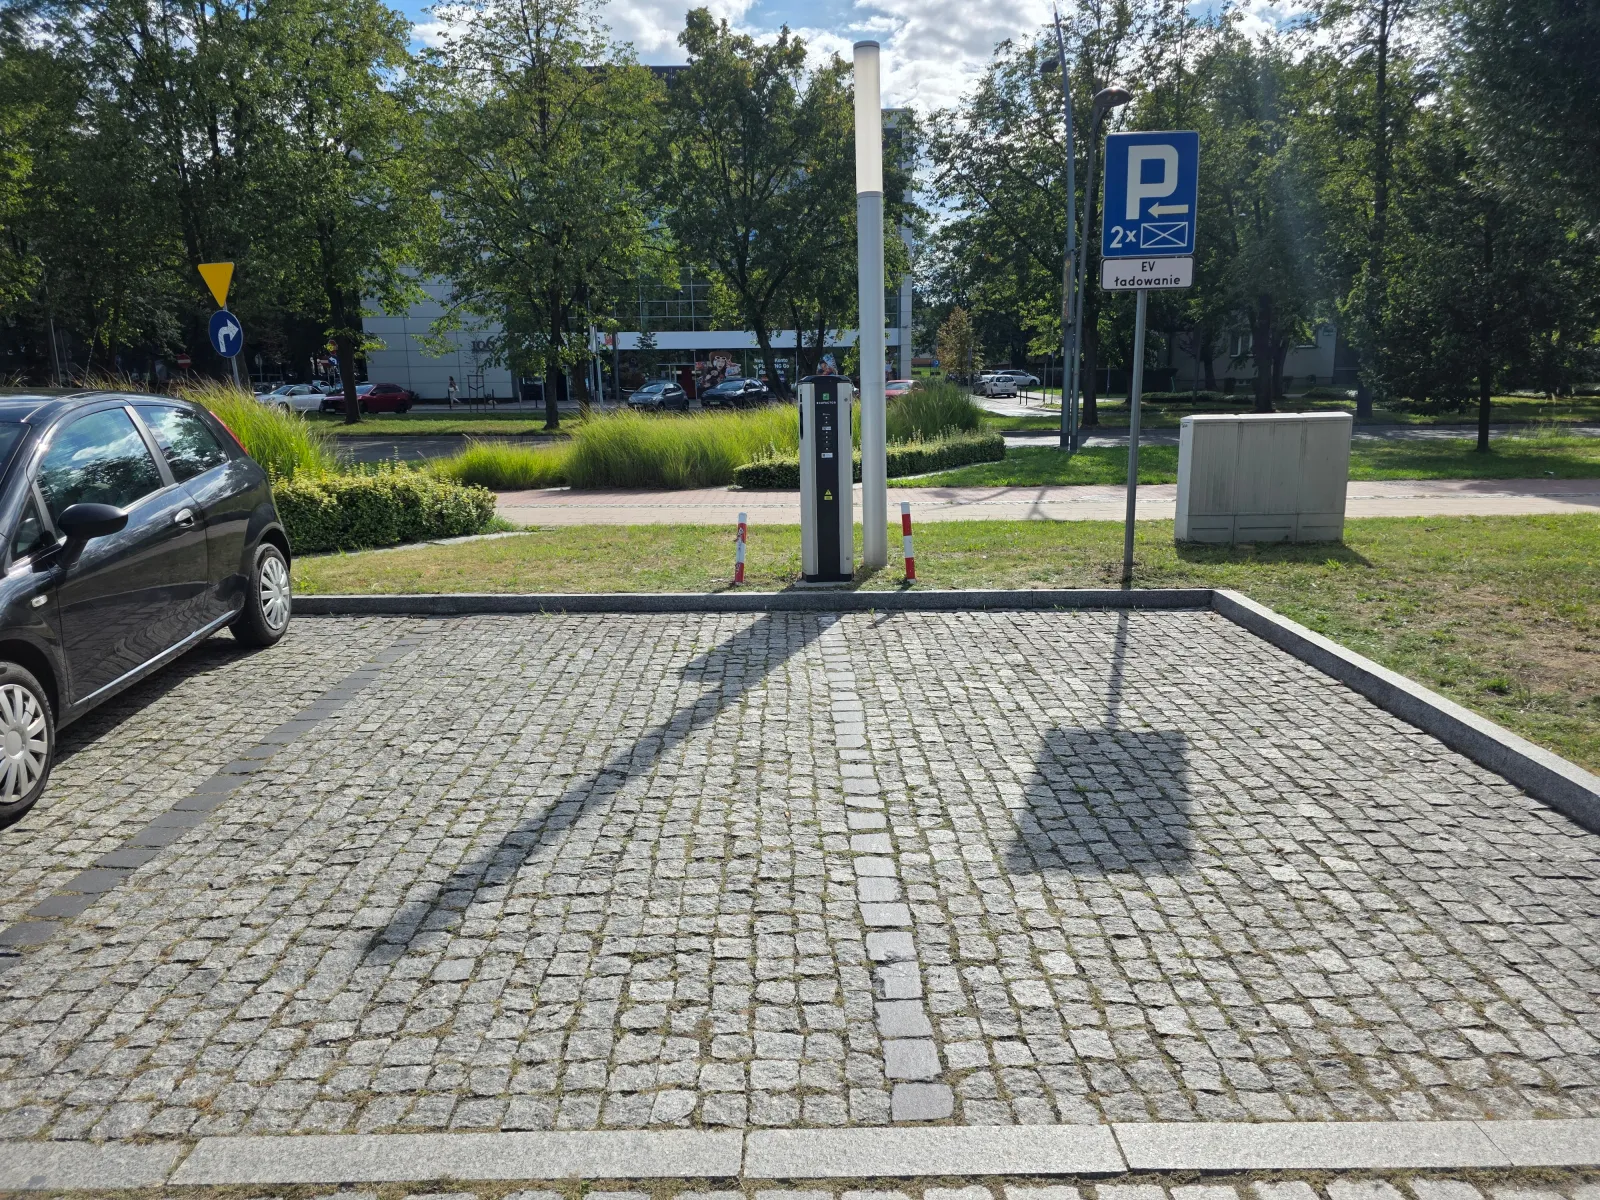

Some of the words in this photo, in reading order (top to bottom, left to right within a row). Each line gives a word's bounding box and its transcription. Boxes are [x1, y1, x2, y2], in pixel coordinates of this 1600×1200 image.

[1126, 144, 1179, 220] P
[1109, 225, 1138, 248] 2x
[1141, 261, 1156, 272] EV
[1114, 274, 1181, 287] ładowanie
[471, 335, 495, 352] 106
